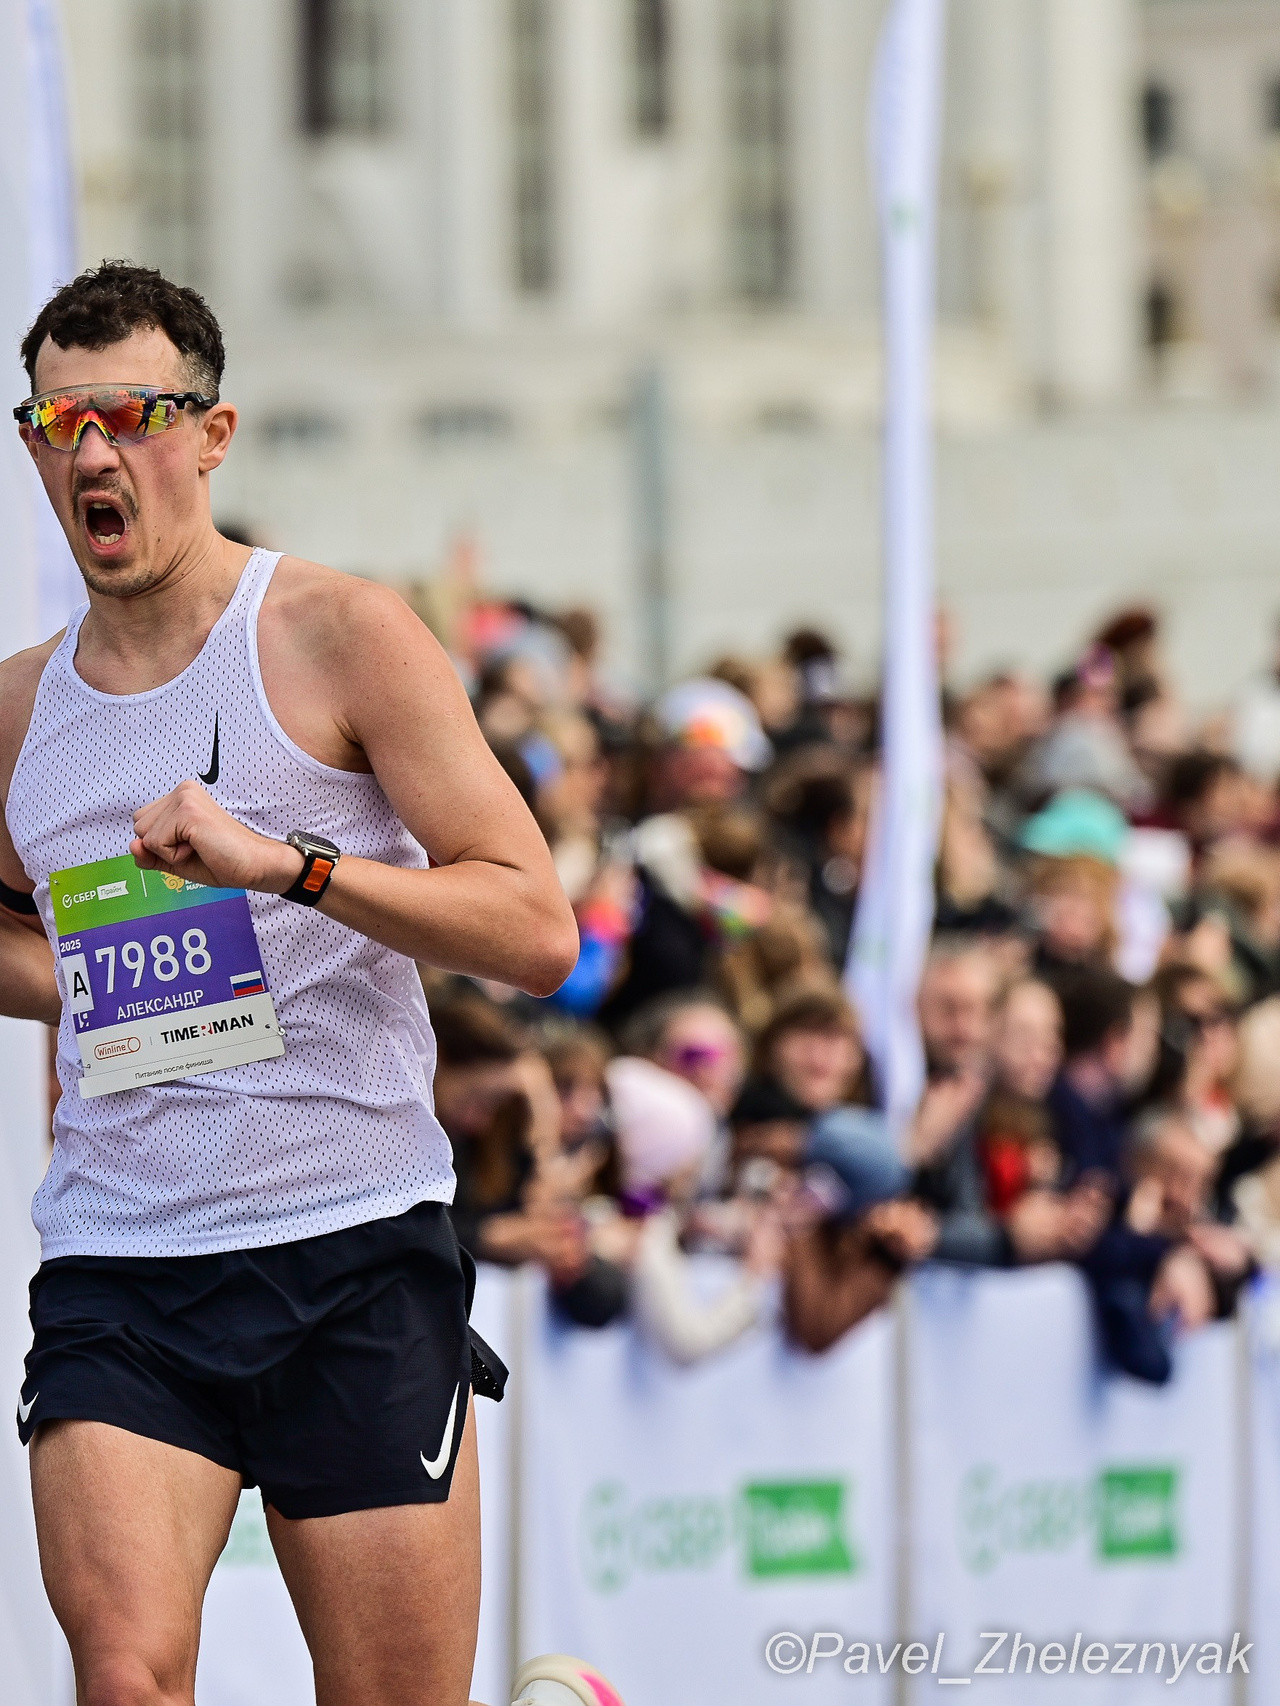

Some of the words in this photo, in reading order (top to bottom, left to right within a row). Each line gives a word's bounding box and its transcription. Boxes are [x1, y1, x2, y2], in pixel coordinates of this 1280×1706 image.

[73, 890, 96, 904] СБЕР
[100, 886, 122, 897] Прайм
[60, 939, 81, 953] 2025
[94, 928, 212, 994] 7988
[117, 989, 204, 1020] АЛЕКСАНДР
[134, 1069, 163, 1080] Питание
[163, 1065, 185, 1074] после
[185, 1059, 214, 1070] финиша
